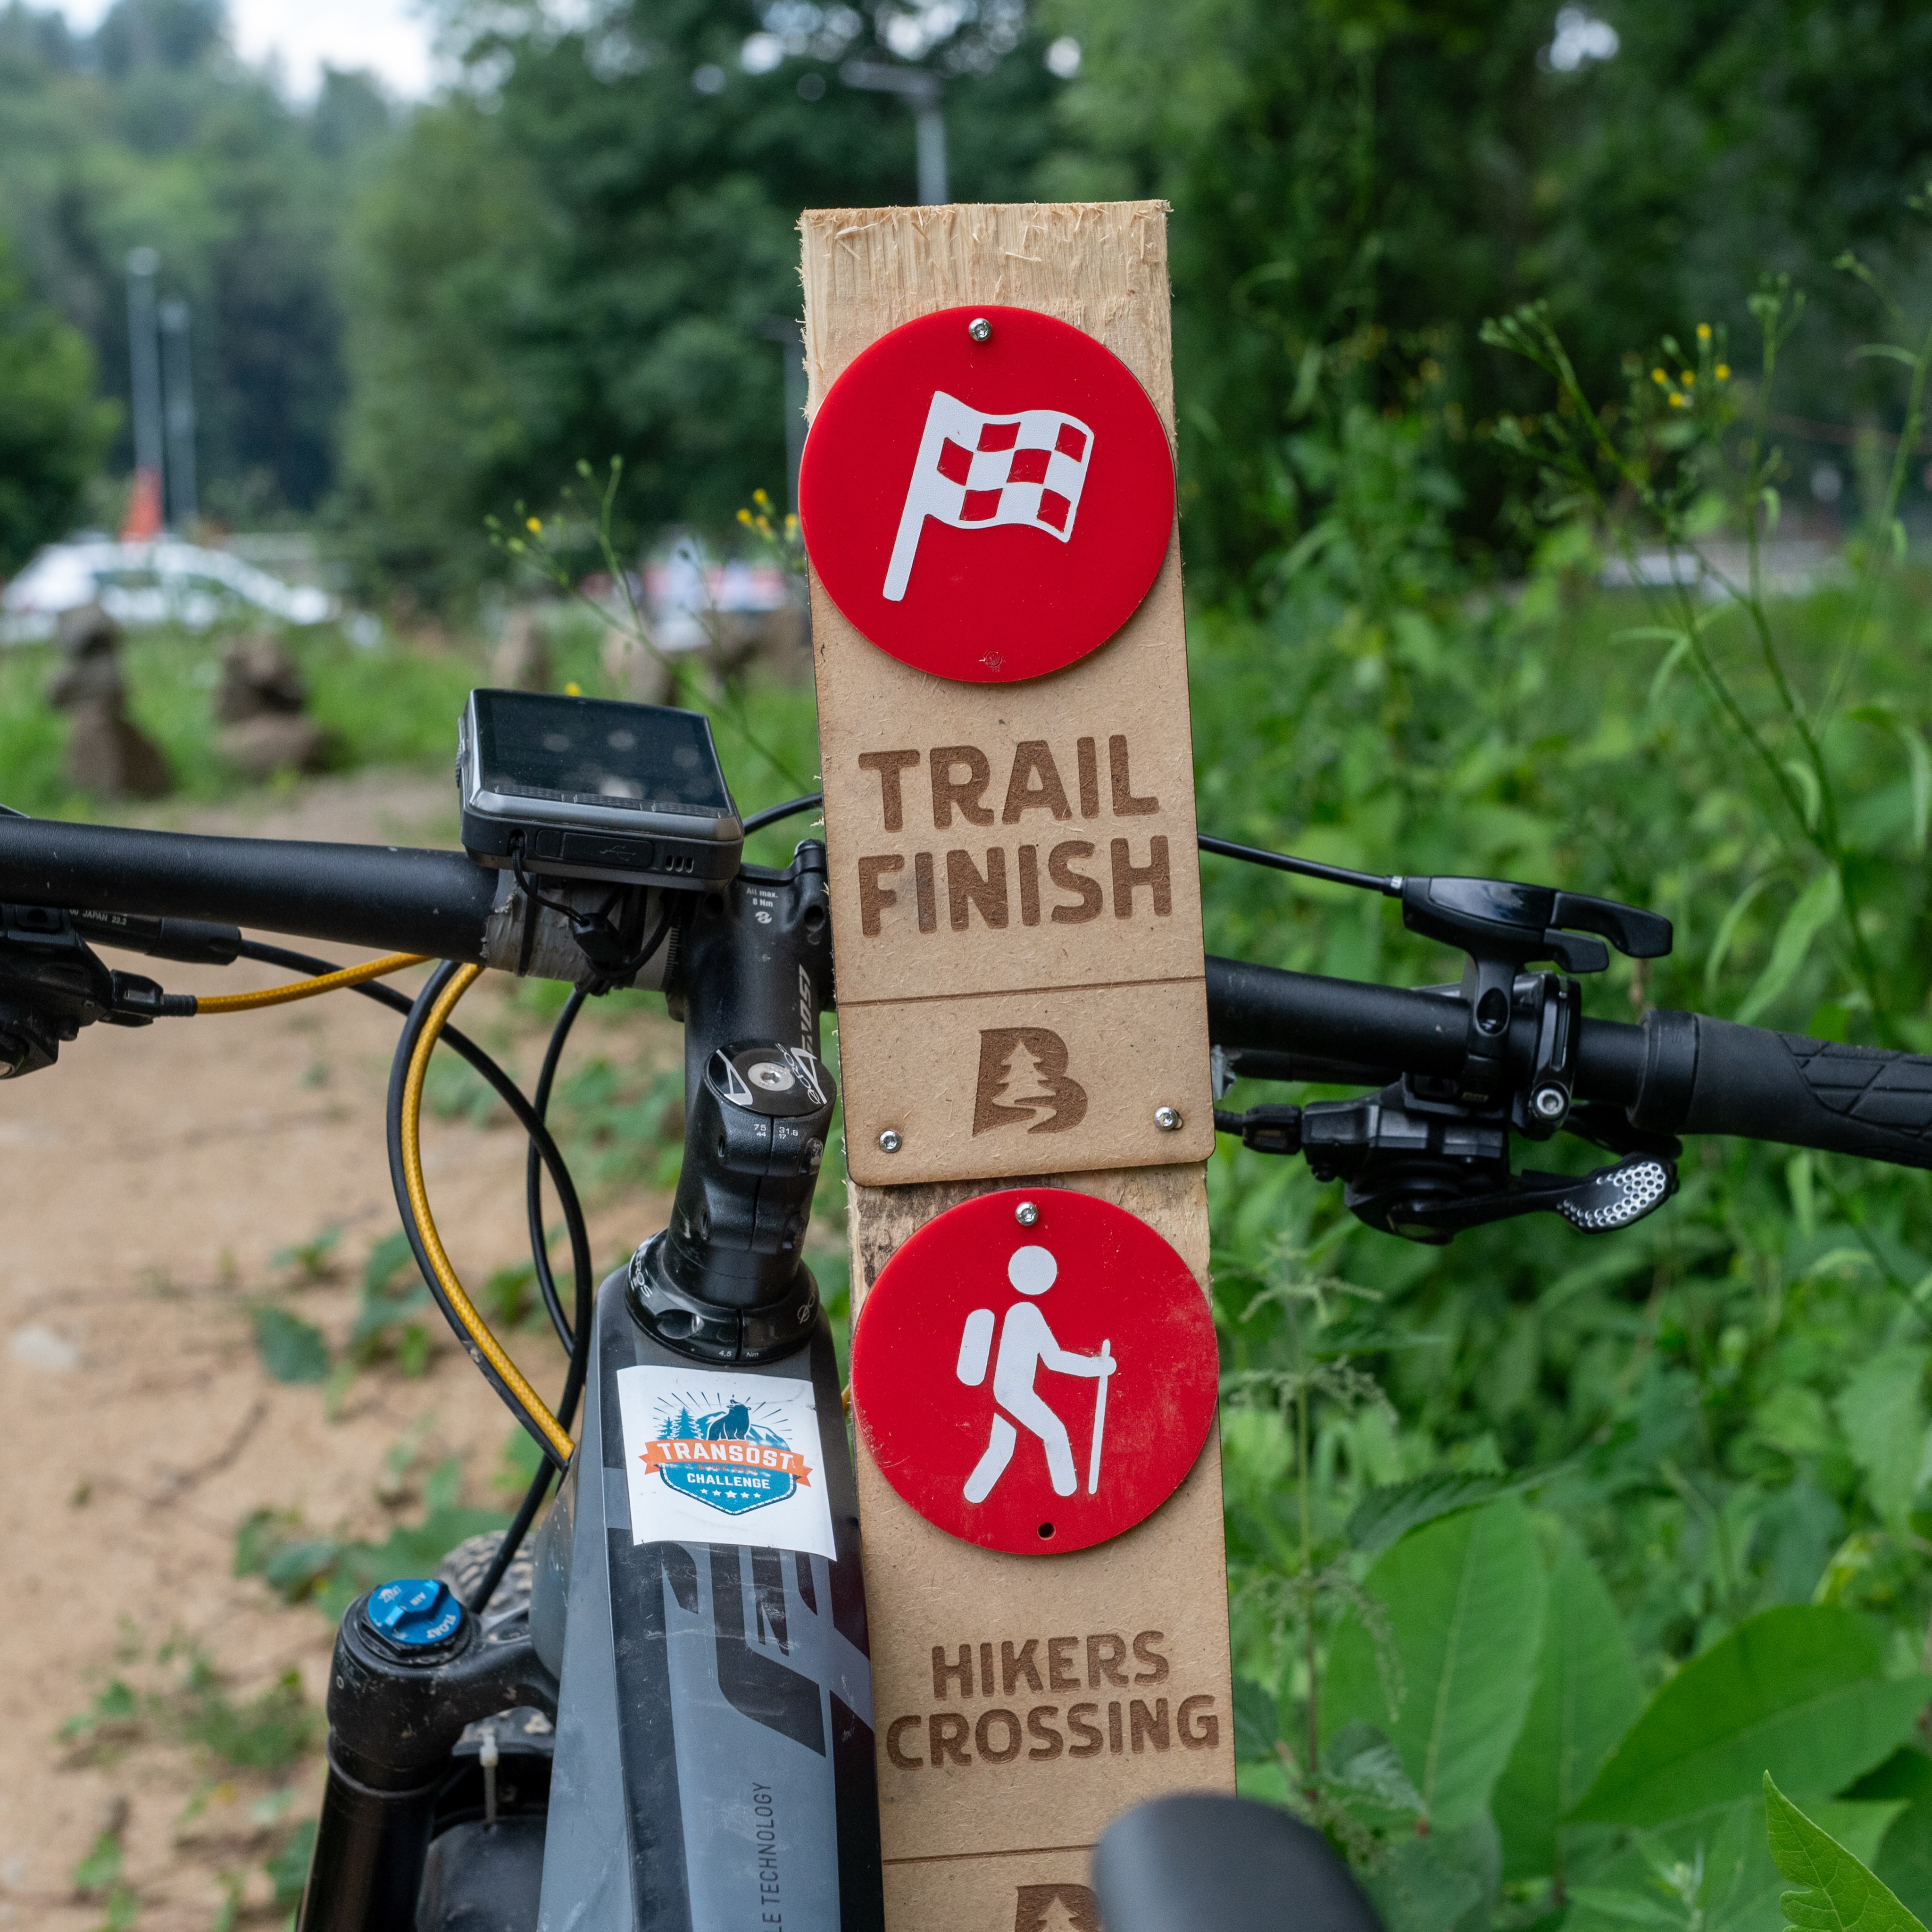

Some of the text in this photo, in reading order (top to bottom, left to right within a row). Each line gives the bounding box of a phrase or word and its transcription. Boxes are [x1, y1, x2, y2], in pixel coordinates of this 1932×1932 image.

[858, 734, 1159, 833] TRAIL
[759, 890, 778, 898] max.
[858, 835, 1172, 938] FINISH
[82, 910, 108, 921] JAPAN
[752, 898, 774, 908] 8 Nm
[778, 1127, 799, 1136] 31.8
[657, 1442, 794, 1470] TRANSOST
[687, 1472, 770, 1489] CHALLENGE
[931, 1630, 1169, 1699] HIKERS
[886, 1694, 1219, 1771] CROSSING
[752, 1782, 780, 1905] TECHNOLOGY
